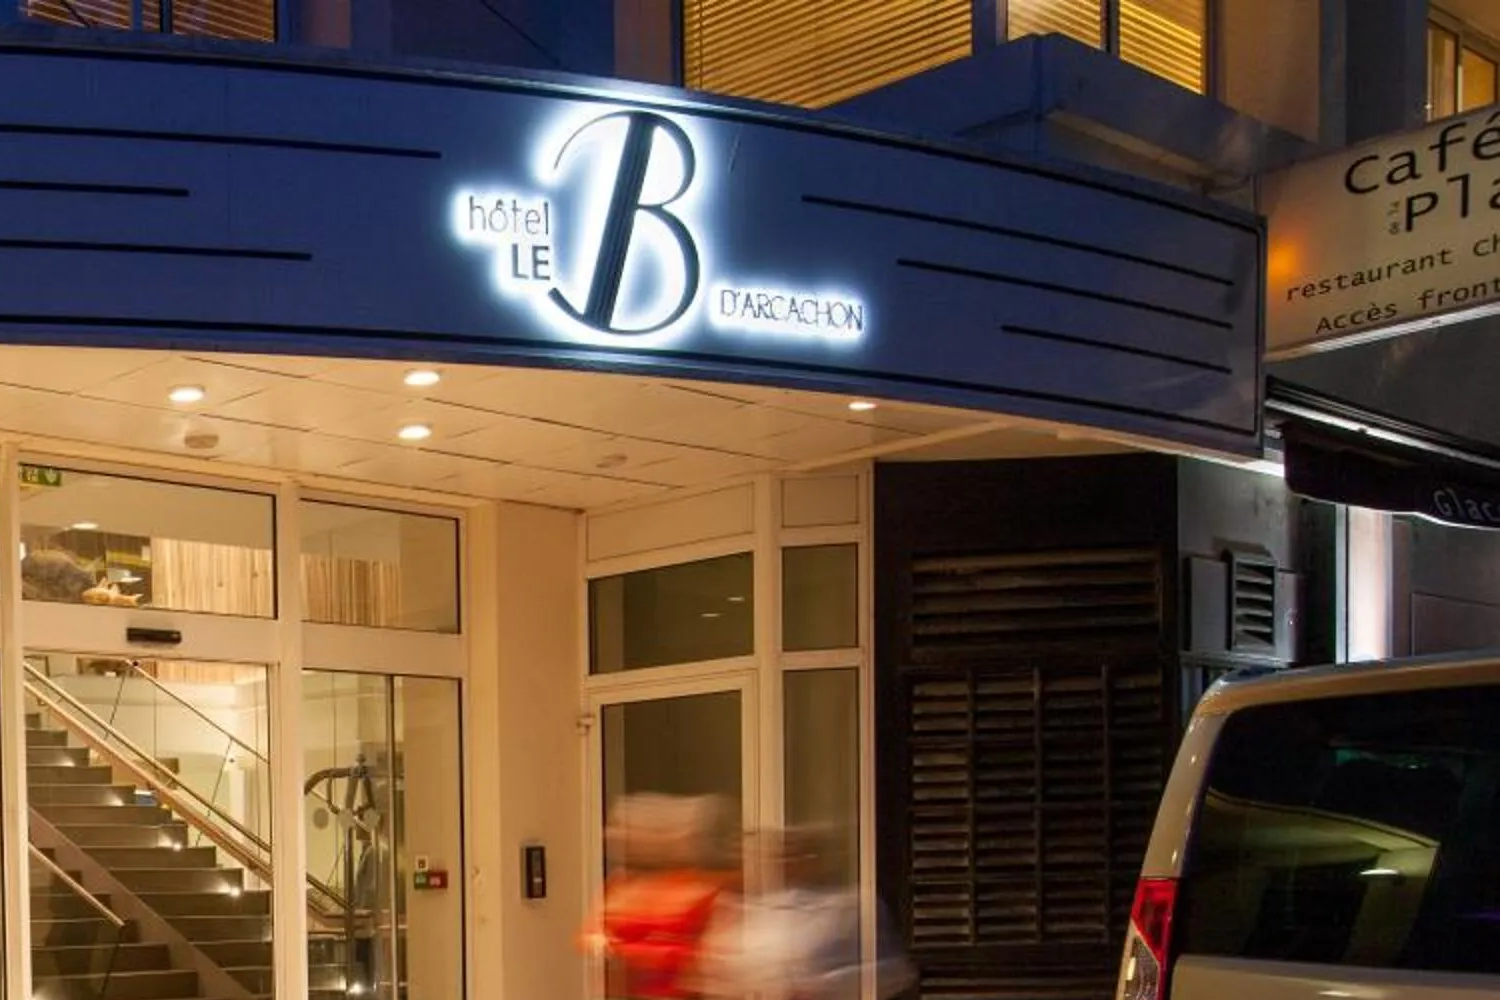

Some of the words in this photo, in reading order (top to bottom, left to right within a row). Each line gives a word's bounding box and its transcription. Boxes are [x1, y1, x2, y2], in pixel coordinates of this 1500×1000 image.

[1344, 112, 1500, 195] Café
[469, 195, 549, 235] hôtel
[512, 243, 551, 281] LE
[548, 110, 701, 335] B
[720, 289, 863, 331] D'ARCACHON
[1286, 248, 1454, 302] restaurant
[1315, 303, 1397, 335] Accès
